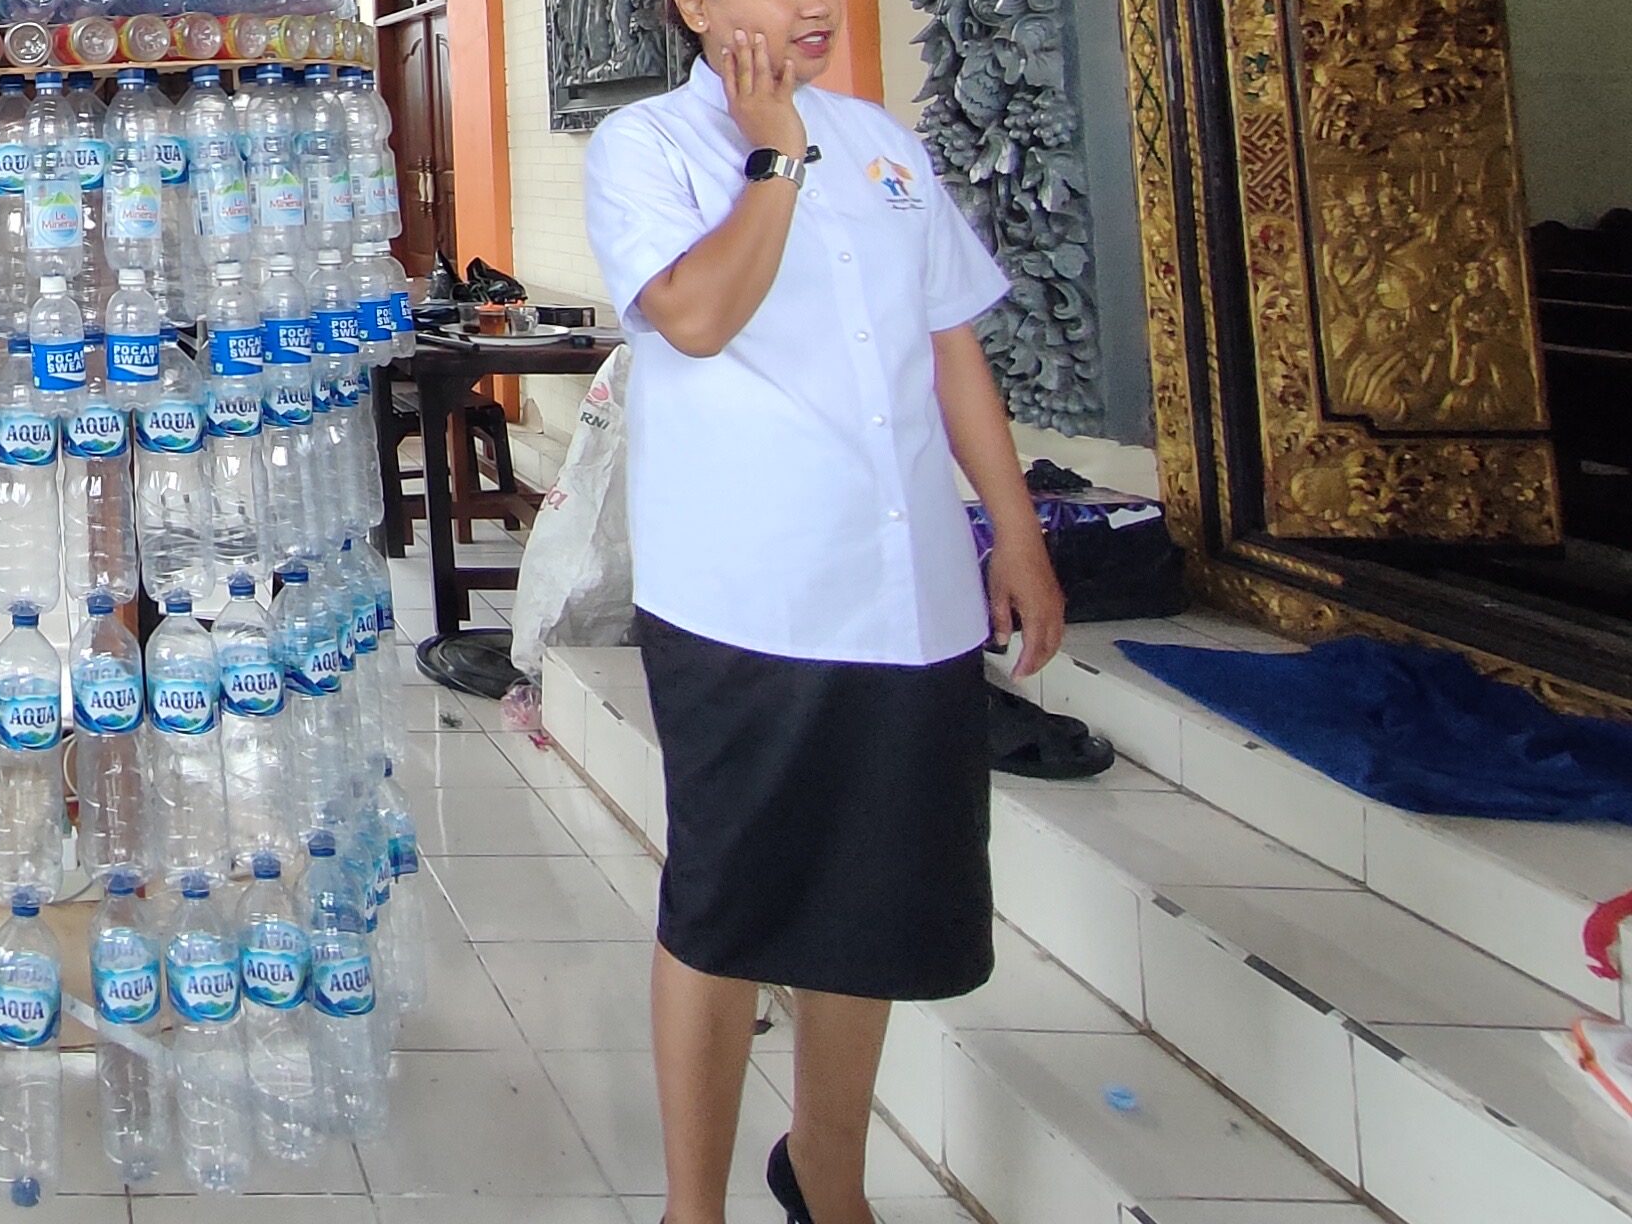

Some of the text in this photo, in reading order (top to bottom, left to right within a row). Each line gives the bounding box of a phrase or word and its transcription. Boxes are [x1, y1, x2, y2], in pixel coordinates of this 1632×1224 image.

[229, 337, 260, 349] POCA
[279, 327, 311, 338] POCA
[113, 343, 158, 355] POCARI
[113, 353, 155, 365] SWEAT
[74, 415, 121, 437] AQUA
[149, 411, 196, 432] AQUA
[580, 411, 610, 431] RNI
[6, 424, 51, 444] AQUA
[311, 650, 338, 673] AQU
[231, 671, 278, 696] AQUA
[90, 687, 137, 712] AQUA
[159, 689, 206, 713] AQUA
[9, 705, 56, 728] AQUA
[247, 959, 295, 986] AQUA
[109, 975, 154, 1002] AQUA
[187, 972, 234, 998] AQUA
